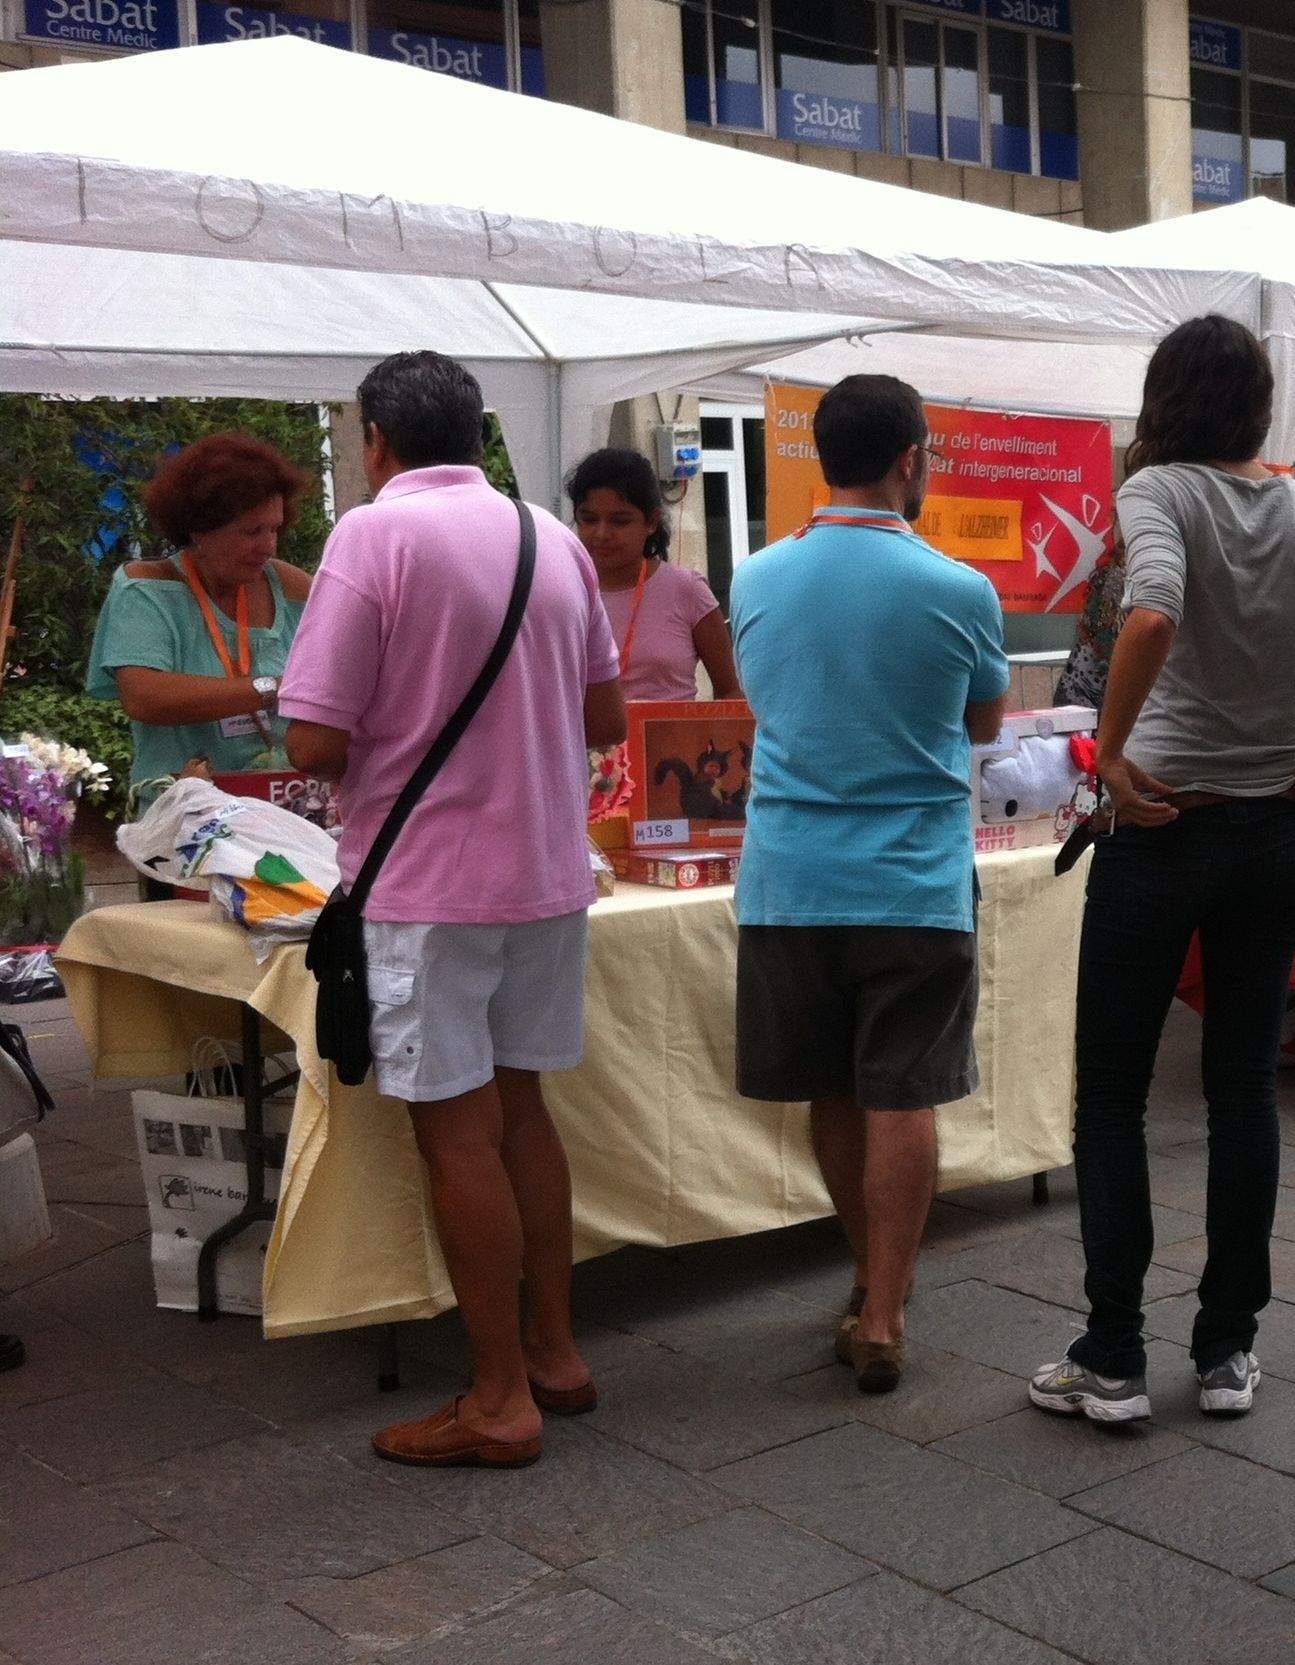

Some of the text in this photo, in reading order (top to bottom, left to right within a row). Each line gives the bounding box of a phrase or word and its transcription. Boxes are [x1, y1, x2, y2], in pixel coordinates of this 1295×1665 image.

[46, 0, 157, 32] Sabat
[46, 20, 102, 41] Centre
[391, 32, 483, 77] Sabat
[1190, 35, 1228, 64] abat
[793, 93, 862, 130] Sabat
[1193, 158, 1231, 185] abat
[776, 409, 815, 431] 201
[950, 431, 970, 449] de
[958, 459, 1083, 484] intergeneracional
[974, 837, 1016, 852] KITTY
